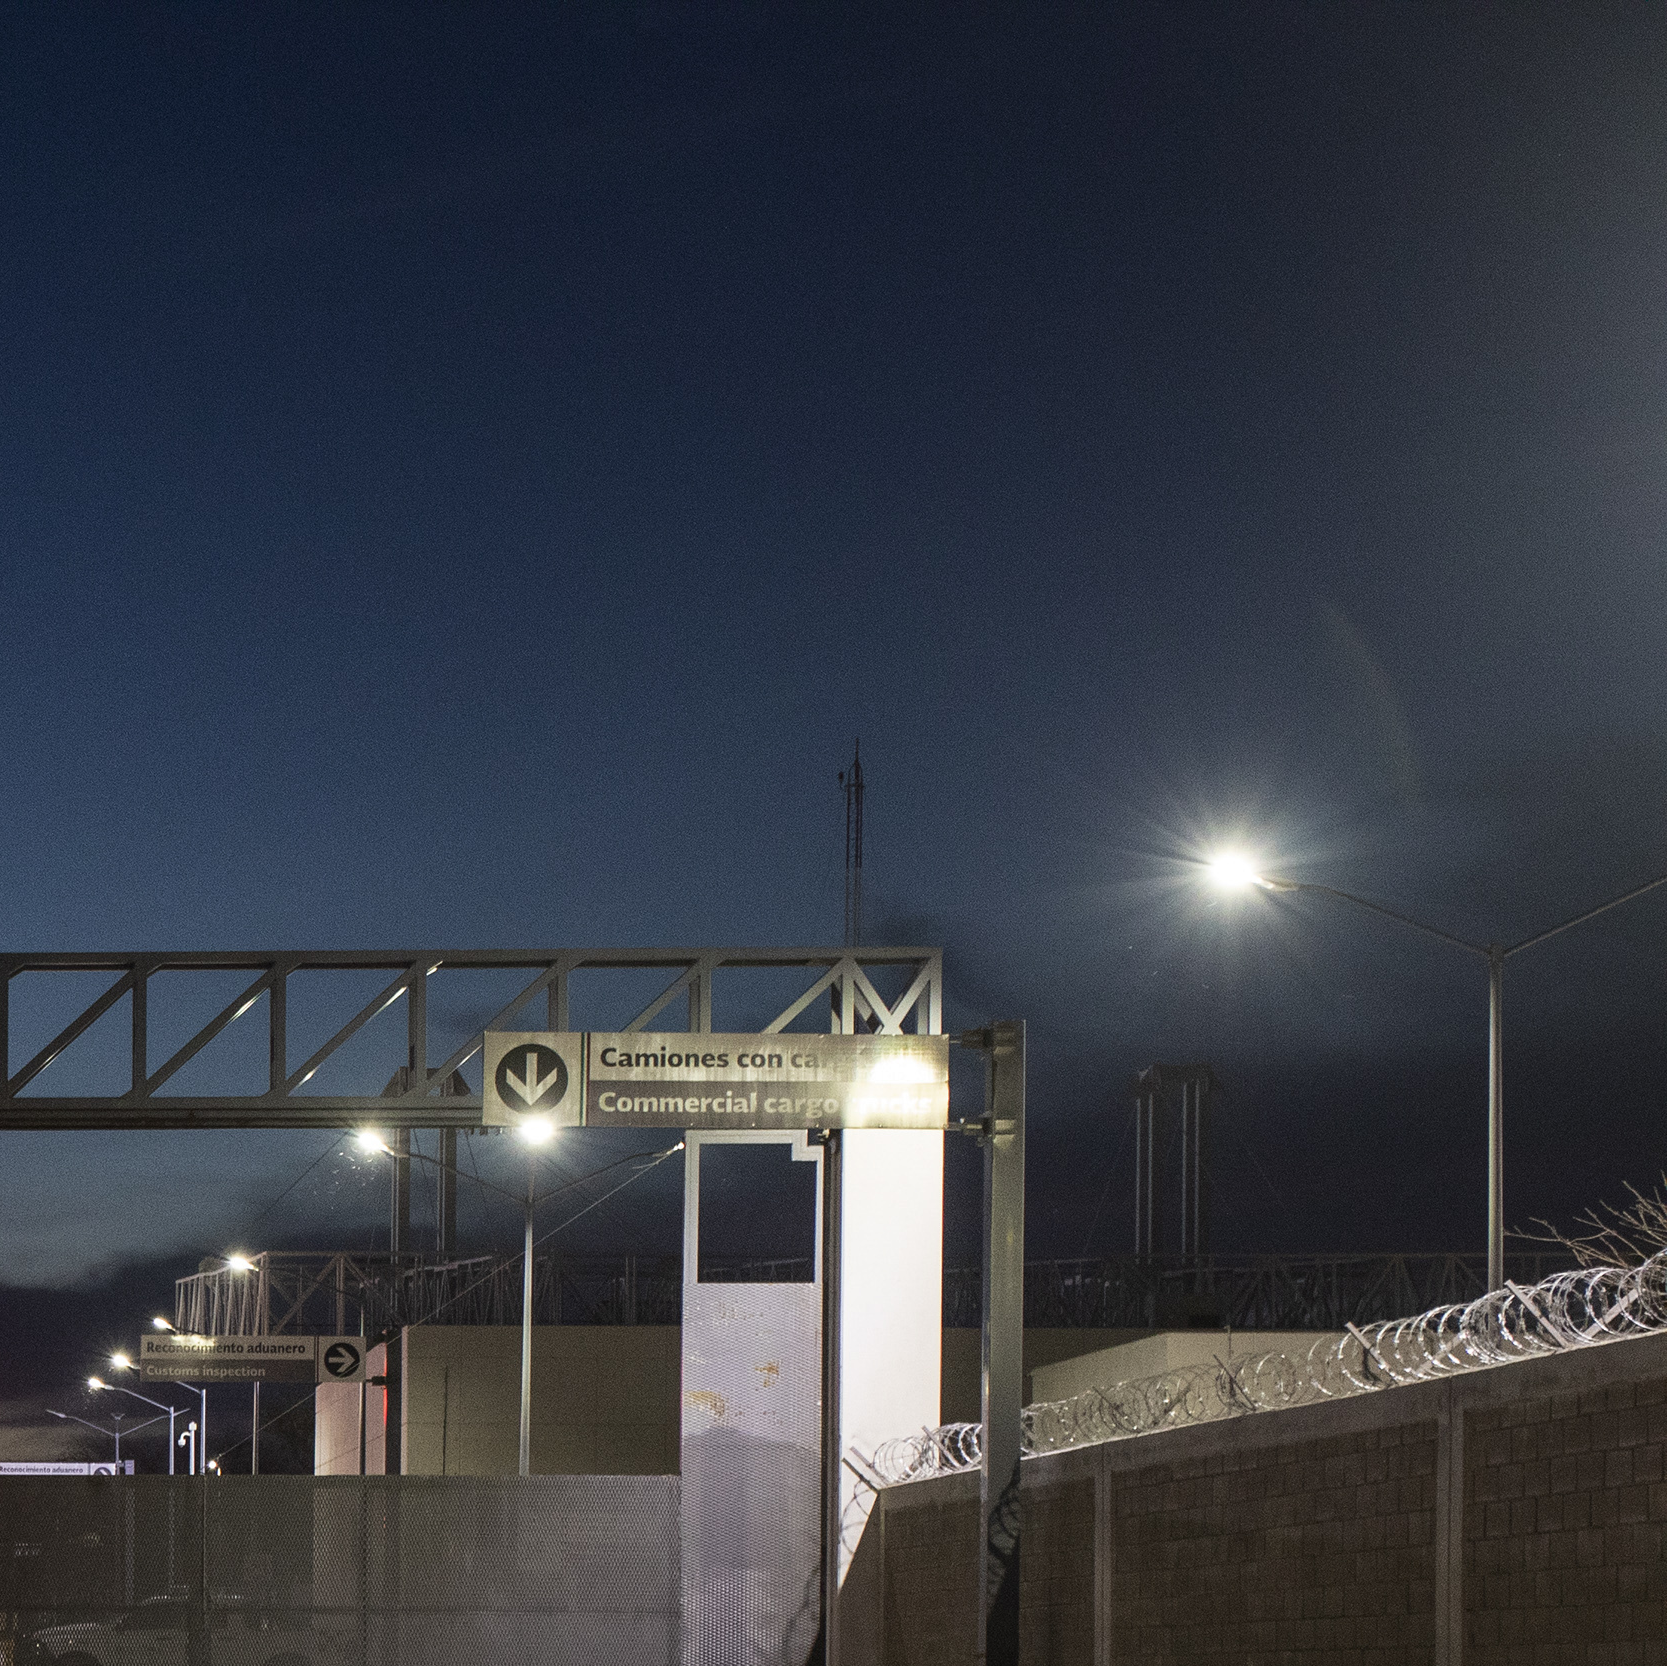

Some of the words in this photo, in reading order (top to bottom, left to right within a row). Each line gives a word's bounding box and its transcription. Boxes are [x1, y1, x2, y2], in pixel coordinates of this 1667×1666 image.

[599, 1047, 729, 1069] Camiones
[737, 1051, 784, 1069] con
[598, 1091, 758, 1114] Commercial
[764, 1097, 840, 1120] cargo
[146, 1342, 244, 1354] Reconocimiento
[247, 1342, 306, 1354] aduanero
[146, 1365, 200, 1377] Customs
[202, 1365, 266, 1378] inspection
